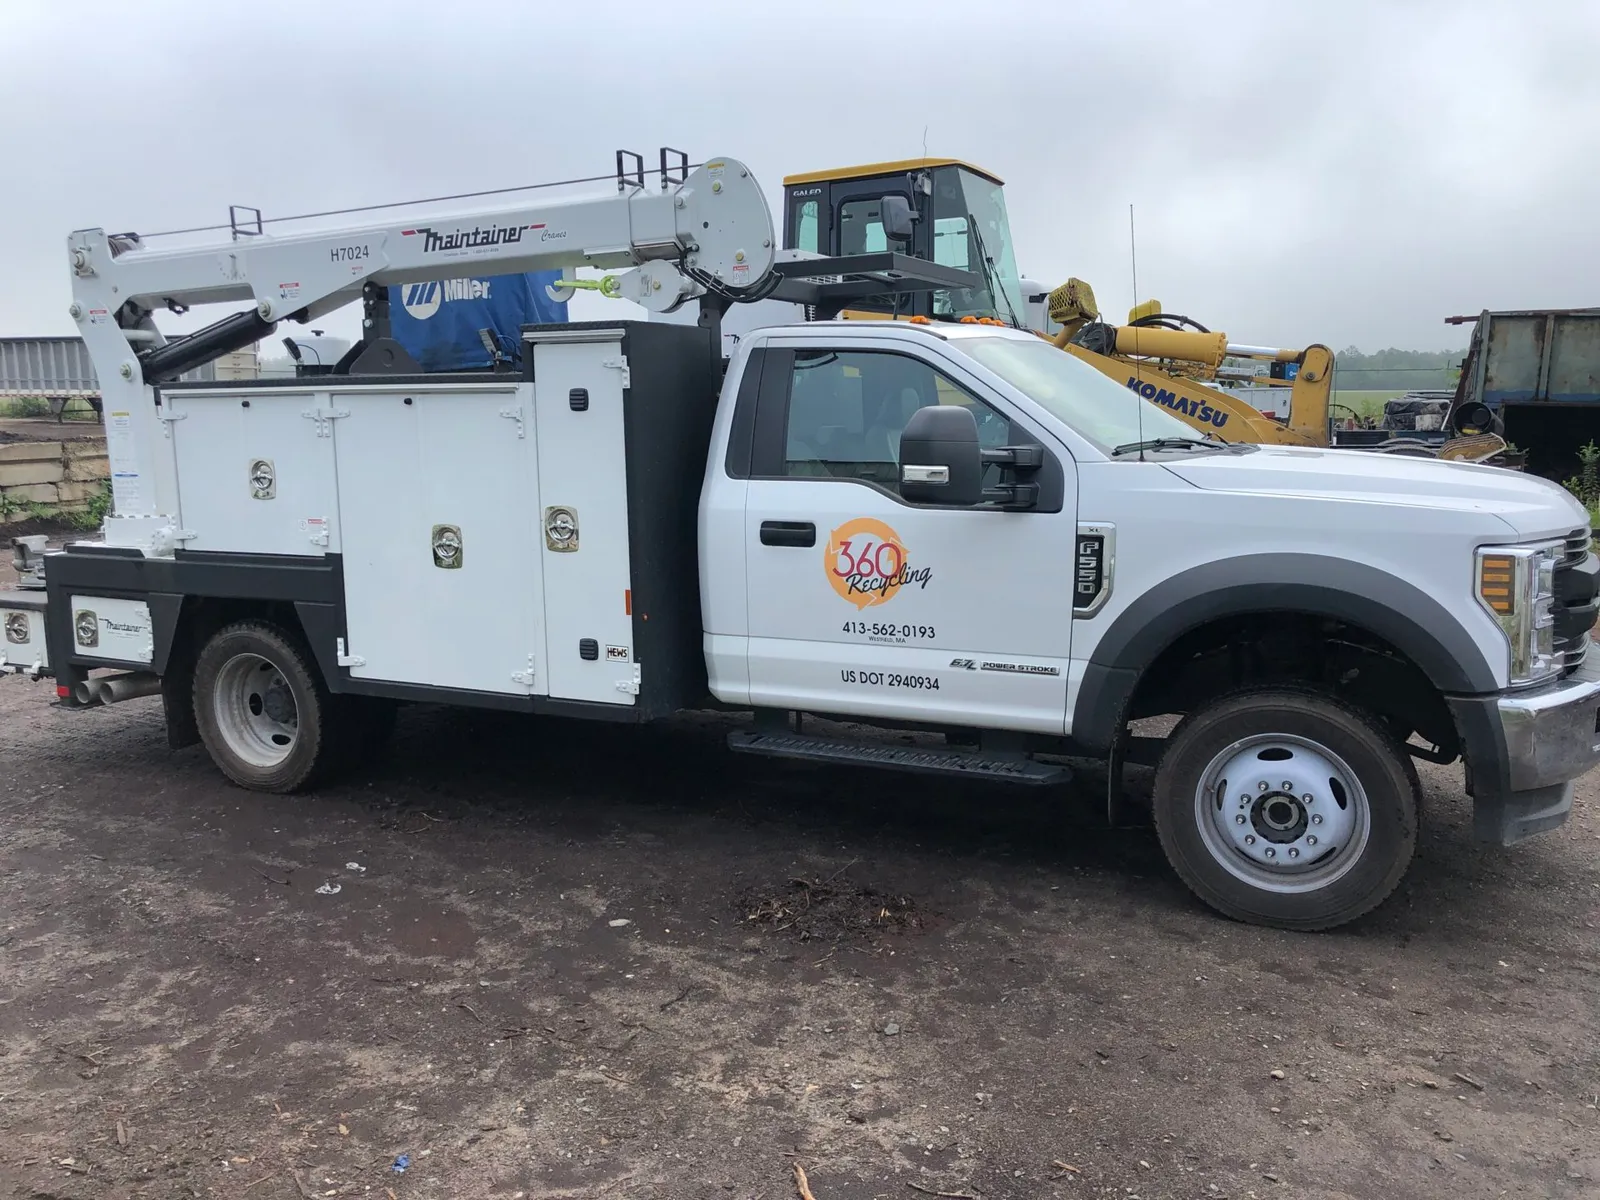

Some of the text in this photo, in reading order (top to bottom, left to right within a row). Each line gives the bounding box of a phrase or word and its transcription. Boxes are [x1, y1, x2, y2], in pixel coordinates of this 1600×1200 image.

[416, 224, 529, 253] Maintainer
[541, 229, 568, 242] Cranes
[330, 244, 370, 262] H7024
[1126, 376, 1229, 428] KOMATSU
[832, 541, 902, 578] 360
[845, 562, 933, 597] Recycling
[842, 621, 936, 639] 413-562-0193
[607, 647, 628, 658] HEWS
[982, 661, 1016, 670] POWER
[1017, 664, 1057, 673] STROKE
[841, 669, 941, 691] US DOT 2940934
